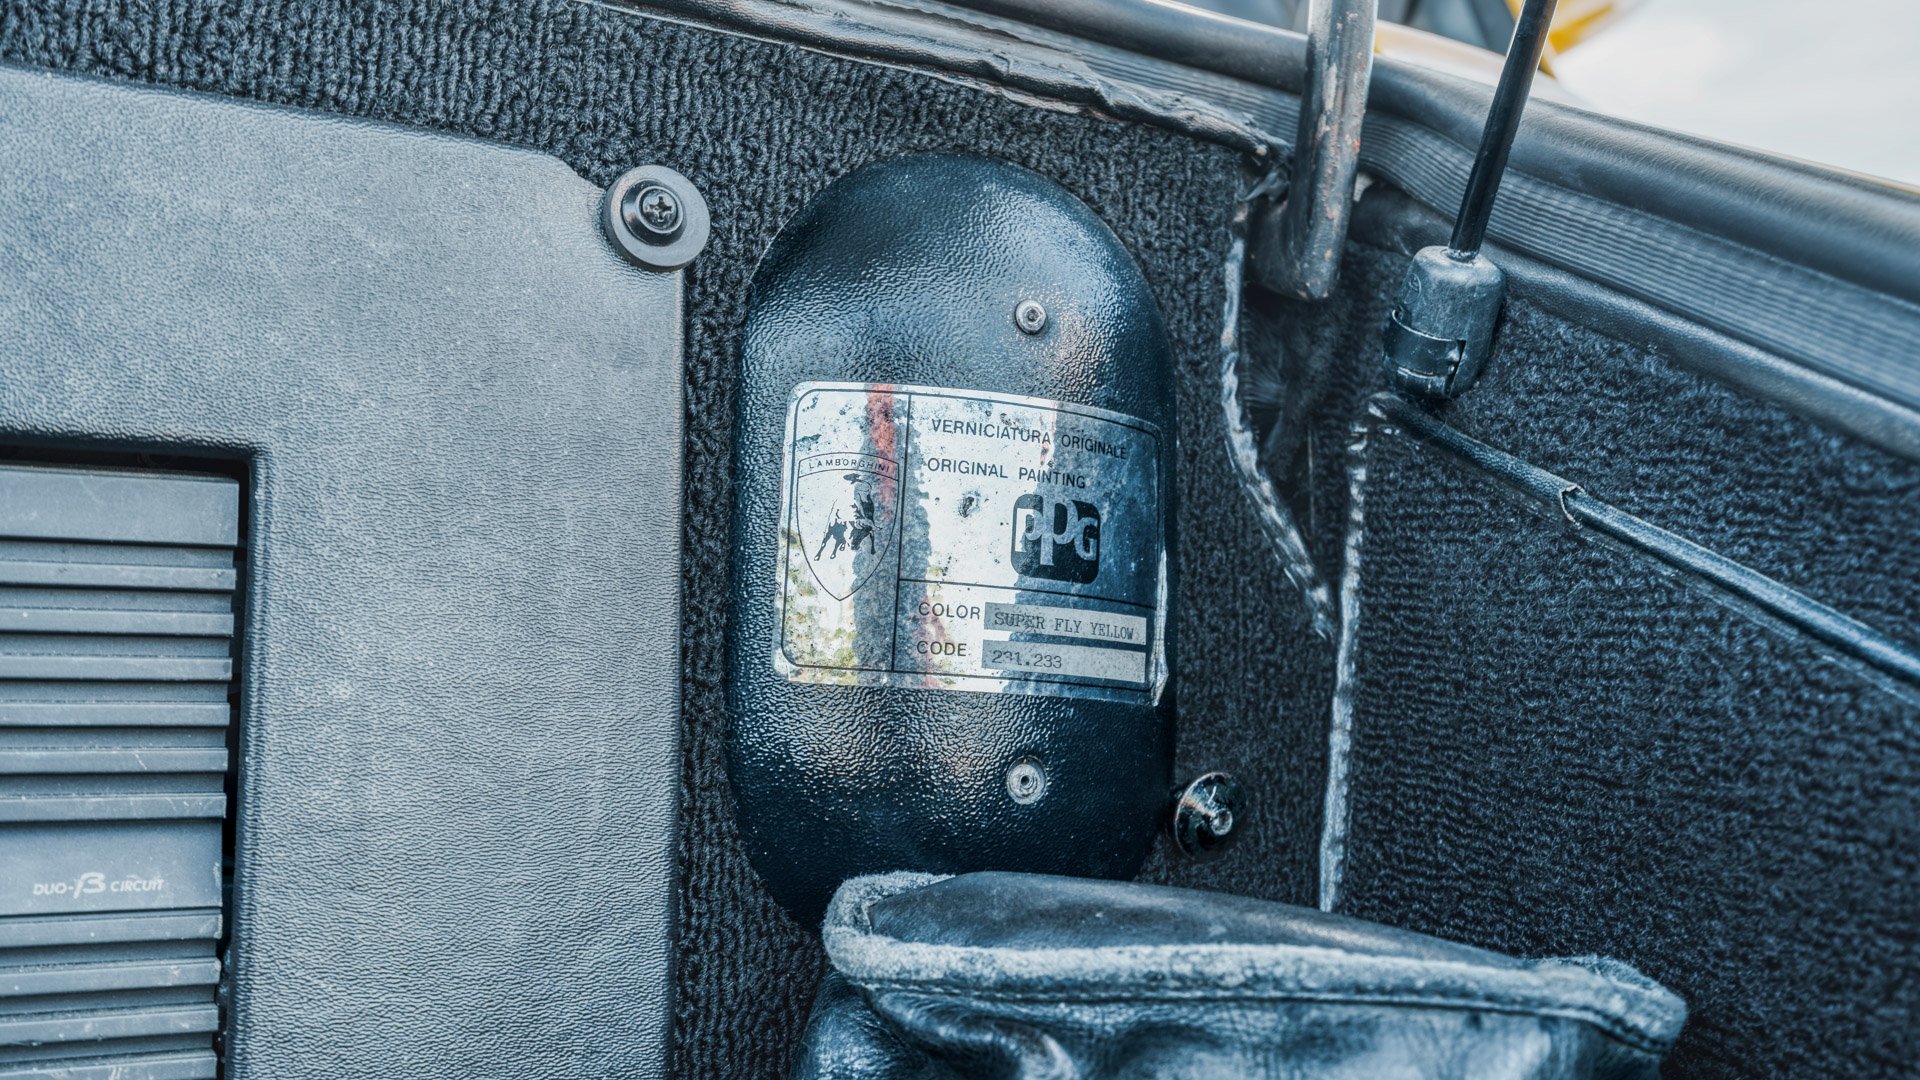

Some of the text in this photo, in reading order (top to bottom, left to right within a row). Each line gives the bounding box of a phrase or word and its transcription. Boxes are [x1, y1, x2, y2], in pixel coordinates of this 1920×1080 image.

[931, 418, 1128, 460] VERNICIATURA ORIGINALE
[808, 458, 891, 473] LAMBORGHINI
[927, 457, 1086, 489] ORIGINAL PAINTING
[918, 602, 1134, 641] COLOR SUPER FLY YELLOW
[916, 640, 967, 657] CODE
[110, 878, 165, 893] CIRCUIT
